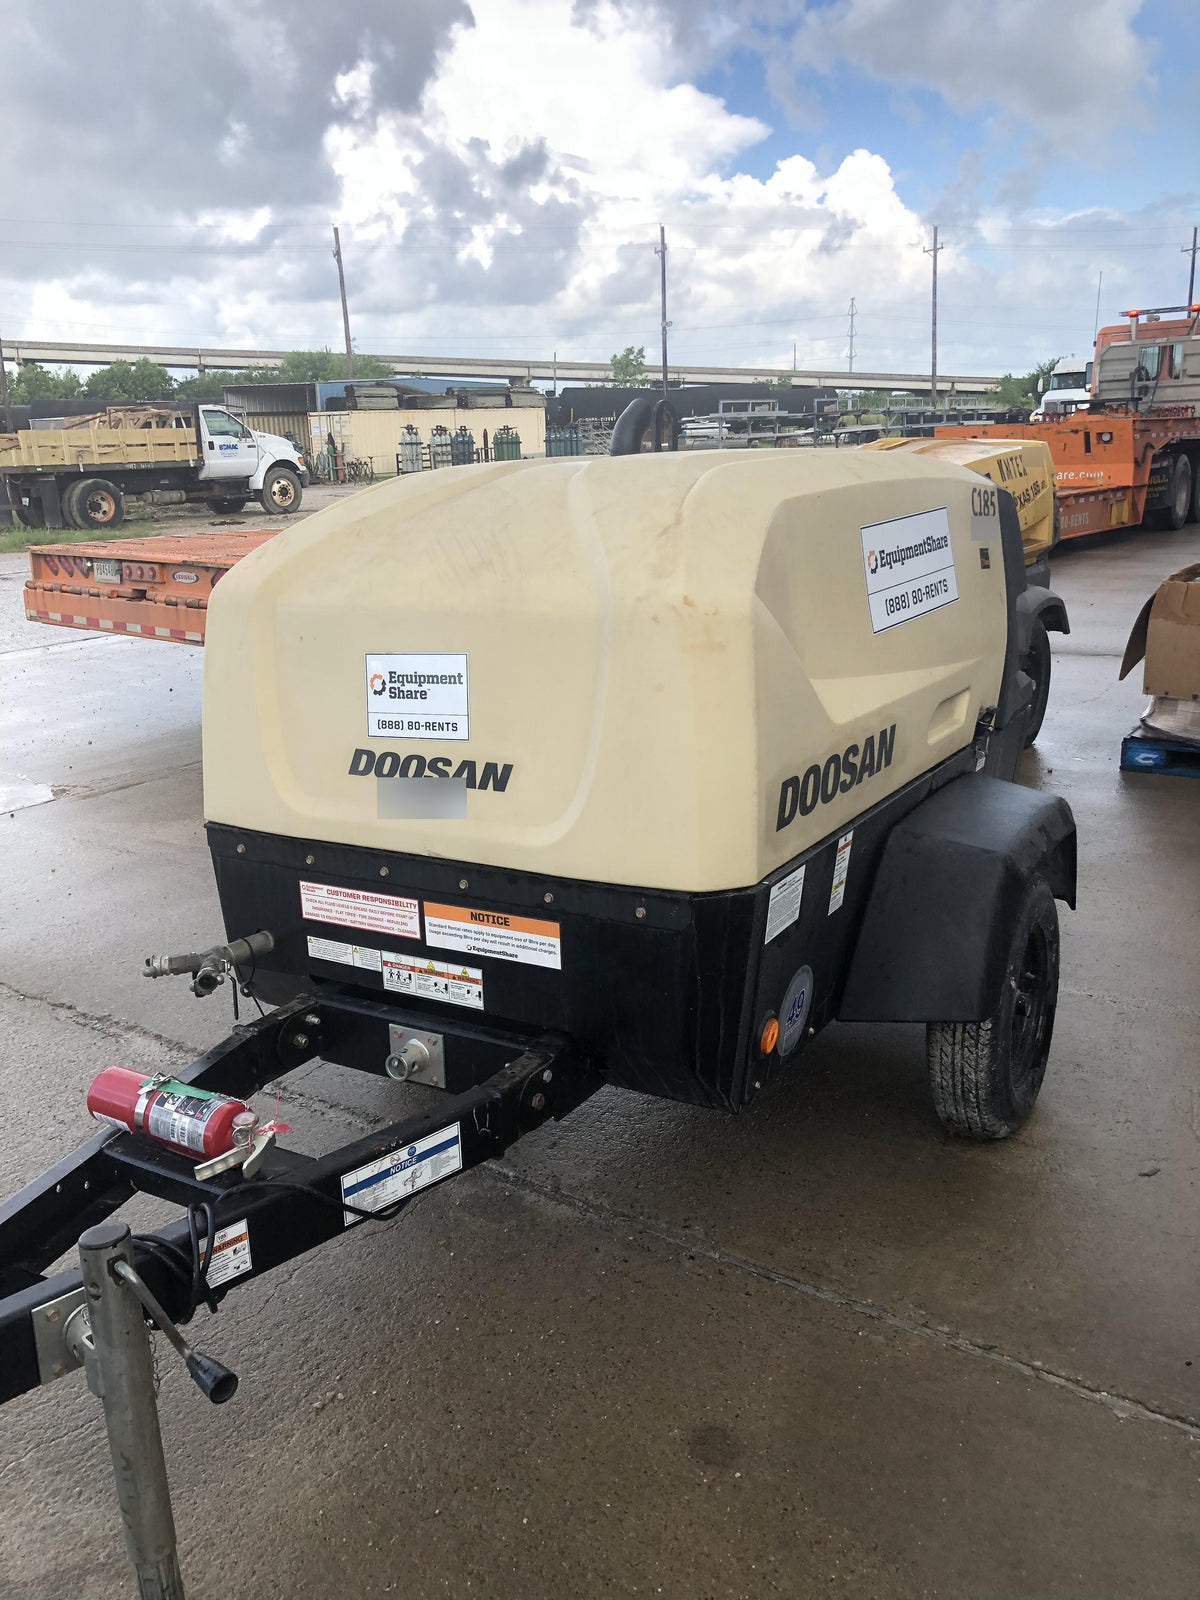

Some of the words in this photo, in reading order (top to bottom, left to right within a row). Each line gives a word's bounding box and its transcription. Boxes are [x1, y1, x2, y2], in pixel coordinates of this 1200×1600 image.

[972, 488, 996, 517] C185
[879, 535, 949, 569] EquipmentShare
[884, 594, 910, 617] (888)
[912, 578, 949, 606] 80-RENTS
[388, 671, 464, 686] Equipment
[388, 687, 428, 700] Share
[378, 720, 404, 730] (888)
[408, 720, 458, 732] 80-RENTS
[776, 724, 896, 832] DOOSAN
[326, 888, 360, 900] CUSTOMER
[362, 896, 416, 909] RESPONSIBILITY
[428, 922, 447, 930] Standard
[470, 912, 510, 926] NOTICE
[442, 932, 462, 940] exceeding
[516, 944, 538, 952] additional
[472, 946, 518, 958] EquipmentShare
[389, 1156, 417, 1175] NOTICE
